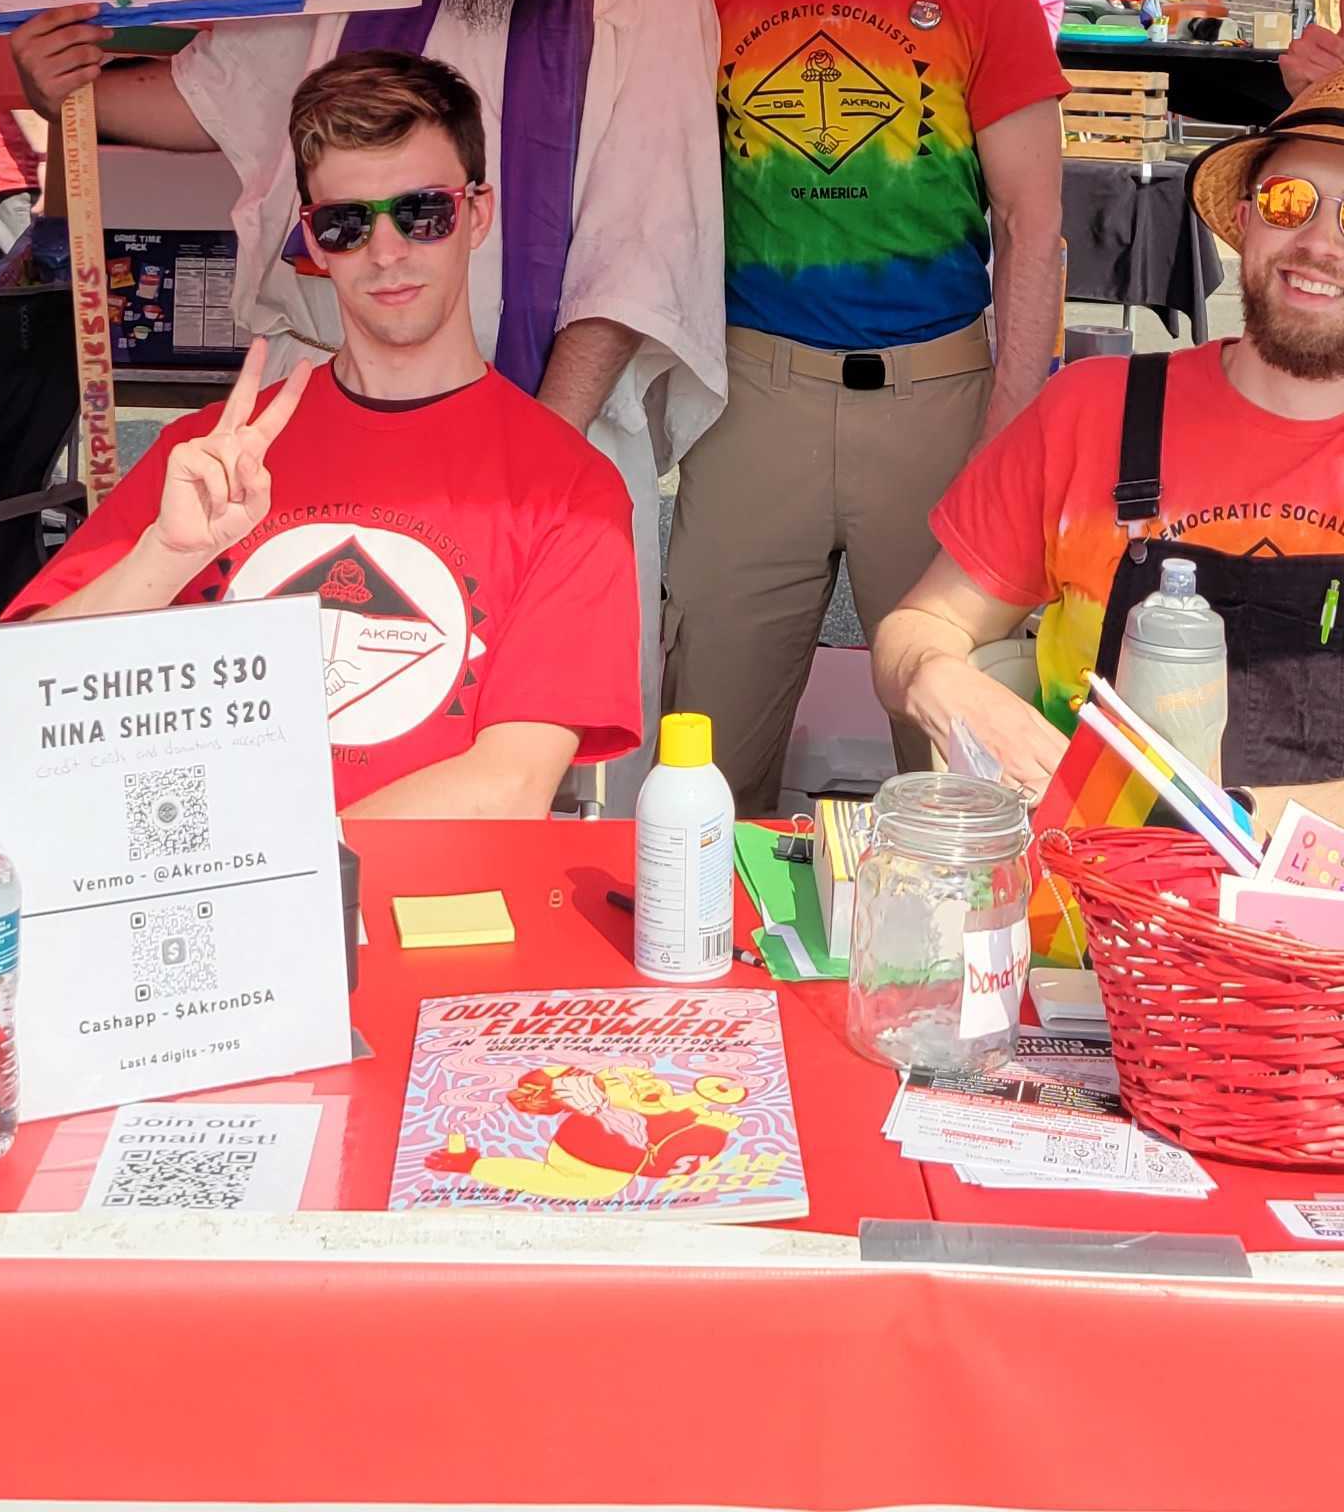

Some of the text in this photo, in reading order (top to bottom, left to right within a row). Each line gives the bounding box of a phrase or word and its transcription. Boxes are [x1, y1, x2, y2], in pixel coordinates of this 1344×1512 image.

[734, 3, 826, 56] DEMOCRATIC
[831, 4, 917, 55] SOCIALISTS
[840, 97, 891, 110] AKRON
[791, 187, 869, 200] OF AMERICA
[1160, 501, 1272, 541] EMOCRATIC
[238, 503, 469, 568] DEMOCRATIC SOCIALISTS
[359, 627, 428, 643] AKRON
[38, 654, 268, 708] T-SHIRTS $30
[41, 699, 273, 750] NINA SHIRTS $20
[72, 853, 268, 893] Venmo @Akron-DSA
[79, 990, 276, 1037] Cashapp $AkronDSA
[440, 998, 708, 1022] OUR WORK IS
[480, 1018, 754, 1038] EVERYWHERE
[486, 1036, 725, 1047] ILLUSTRATED ORAL HISTORY
[119, 1039, 241, 1070] Last 4 digits 7995
[124, 1115, 262, 1128] Join our
[118, 1132, 278, 1145] email list!
